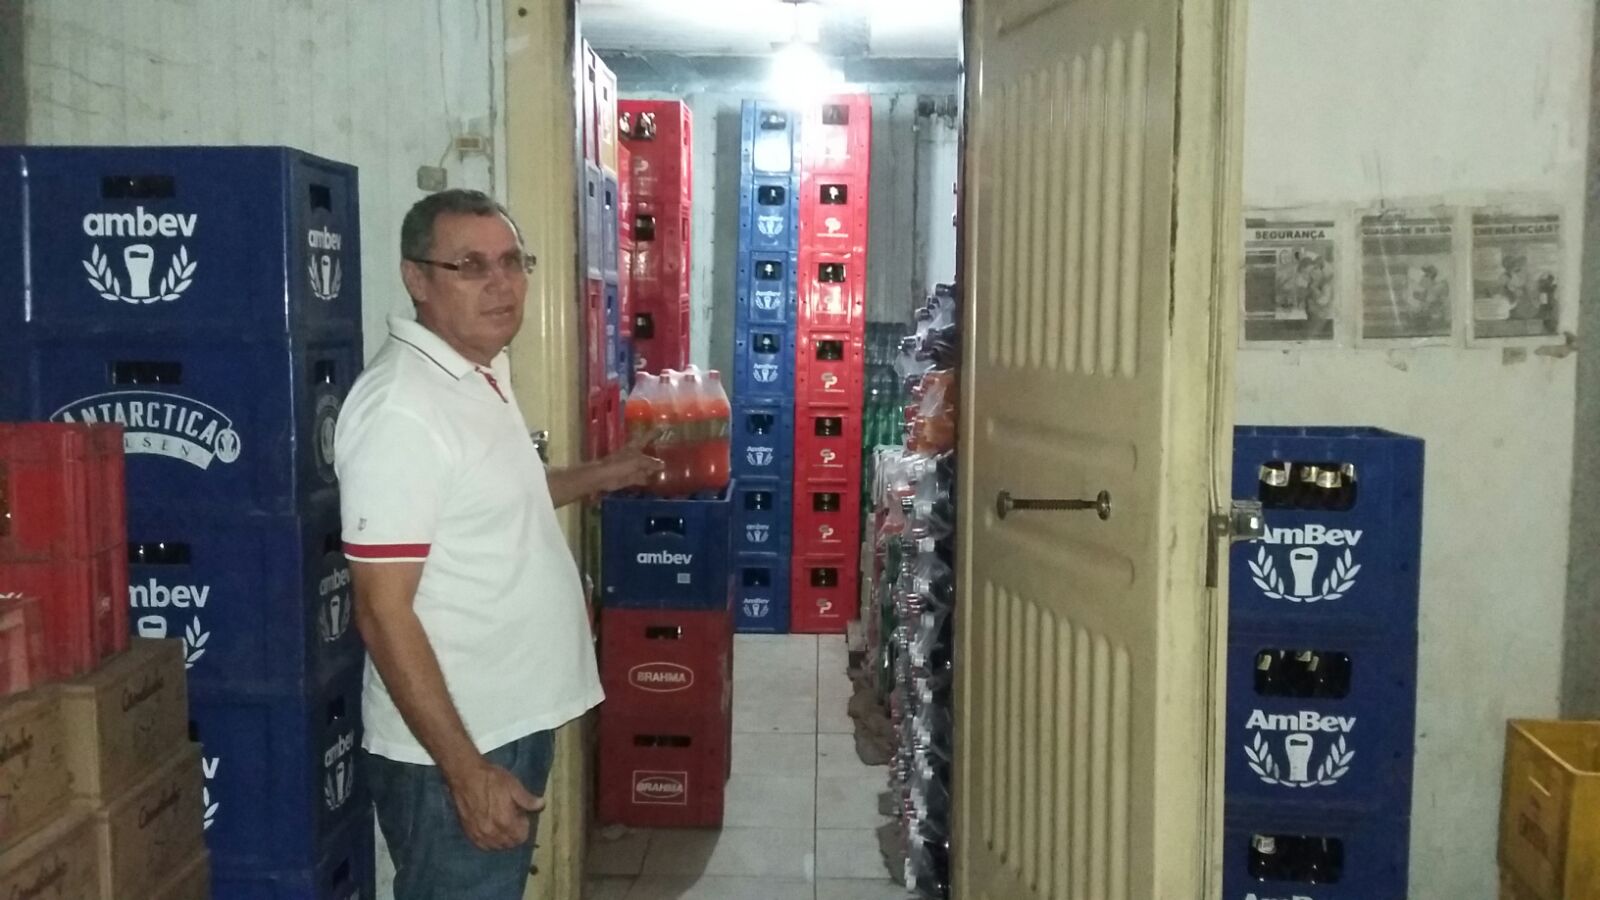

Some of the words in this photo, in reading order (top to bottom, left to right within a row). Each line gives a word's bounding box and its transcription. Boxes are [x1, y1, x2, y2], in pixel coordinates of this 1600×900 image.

[83, 206, 197, 237] ambev
[308, 225, 341, 250] ambev
[1255, 229, 1326, 241] SEGURANÇA
[637, 550, 692, 565] ambev
[128, 578, 210, 609] mbev
[636, 671, 687, 684] BRAHMA
[1245, 709, 1357, 733] AmBev
[635, 780, 684, 794] BRAHMA
